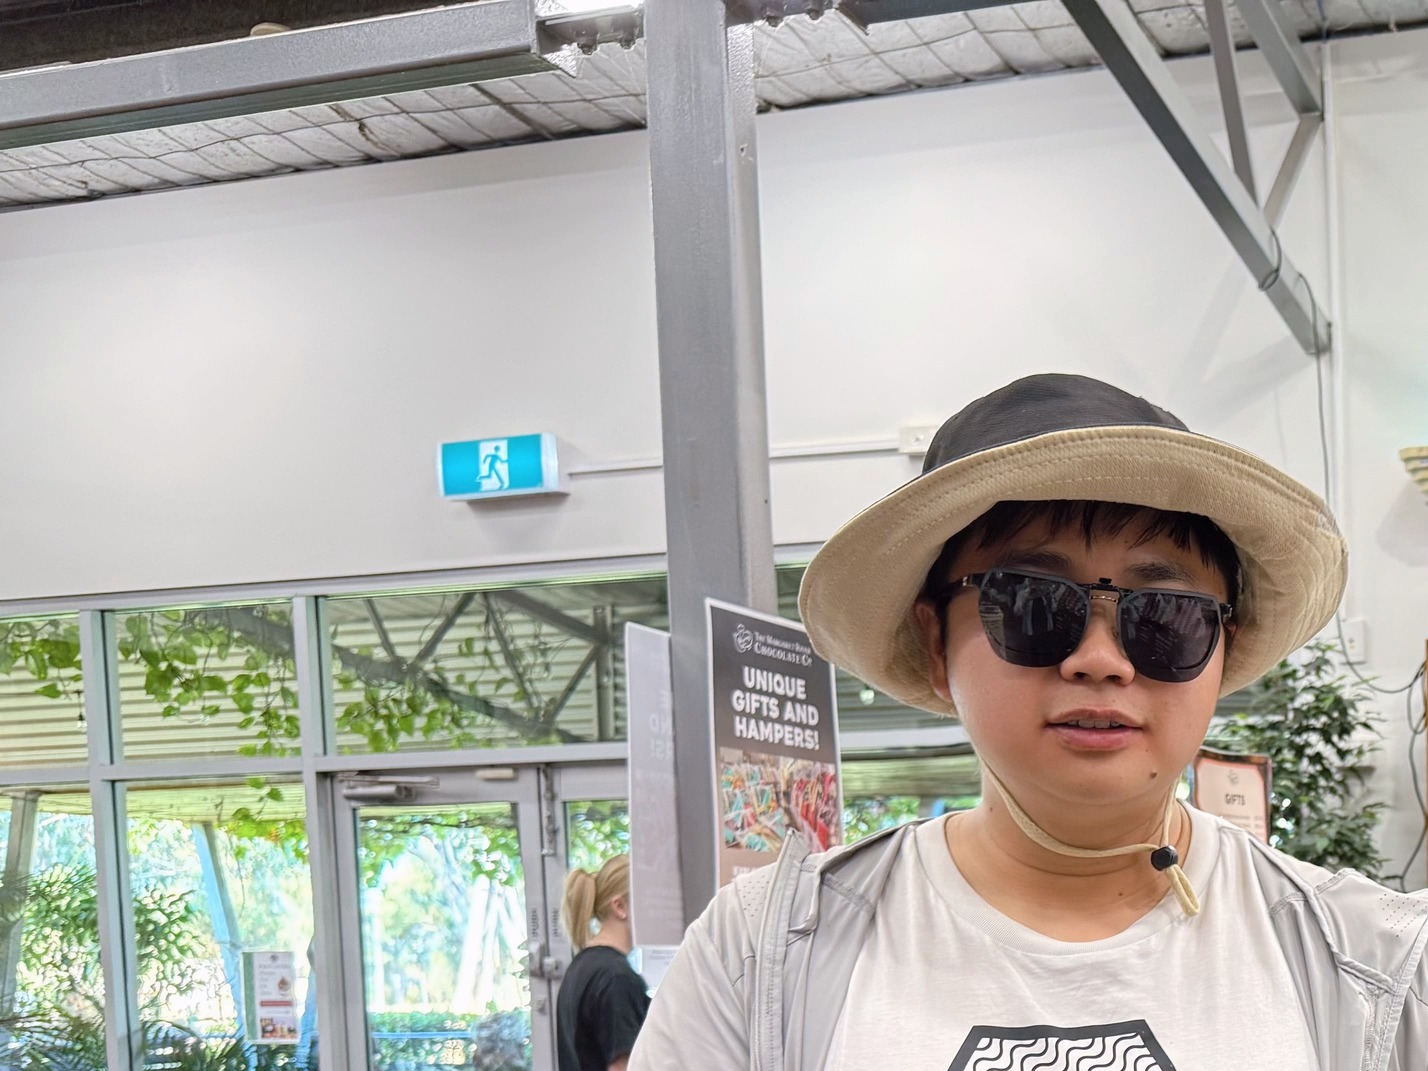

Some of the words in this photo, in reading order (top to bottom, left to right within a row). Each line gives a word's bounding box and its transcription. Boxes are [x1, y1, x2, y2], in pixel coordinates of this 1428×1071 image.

[754, 642, 801, 665] CHOCOLATE
[743, 665, 807, 700] UNIQUE
[731, 689, 780, 719] GIFTS
[784, 701, 819, 726] AND
[734, 715, 820, 751] HAMPERS!
[1223, 793, 1246, 806] GIFTS
